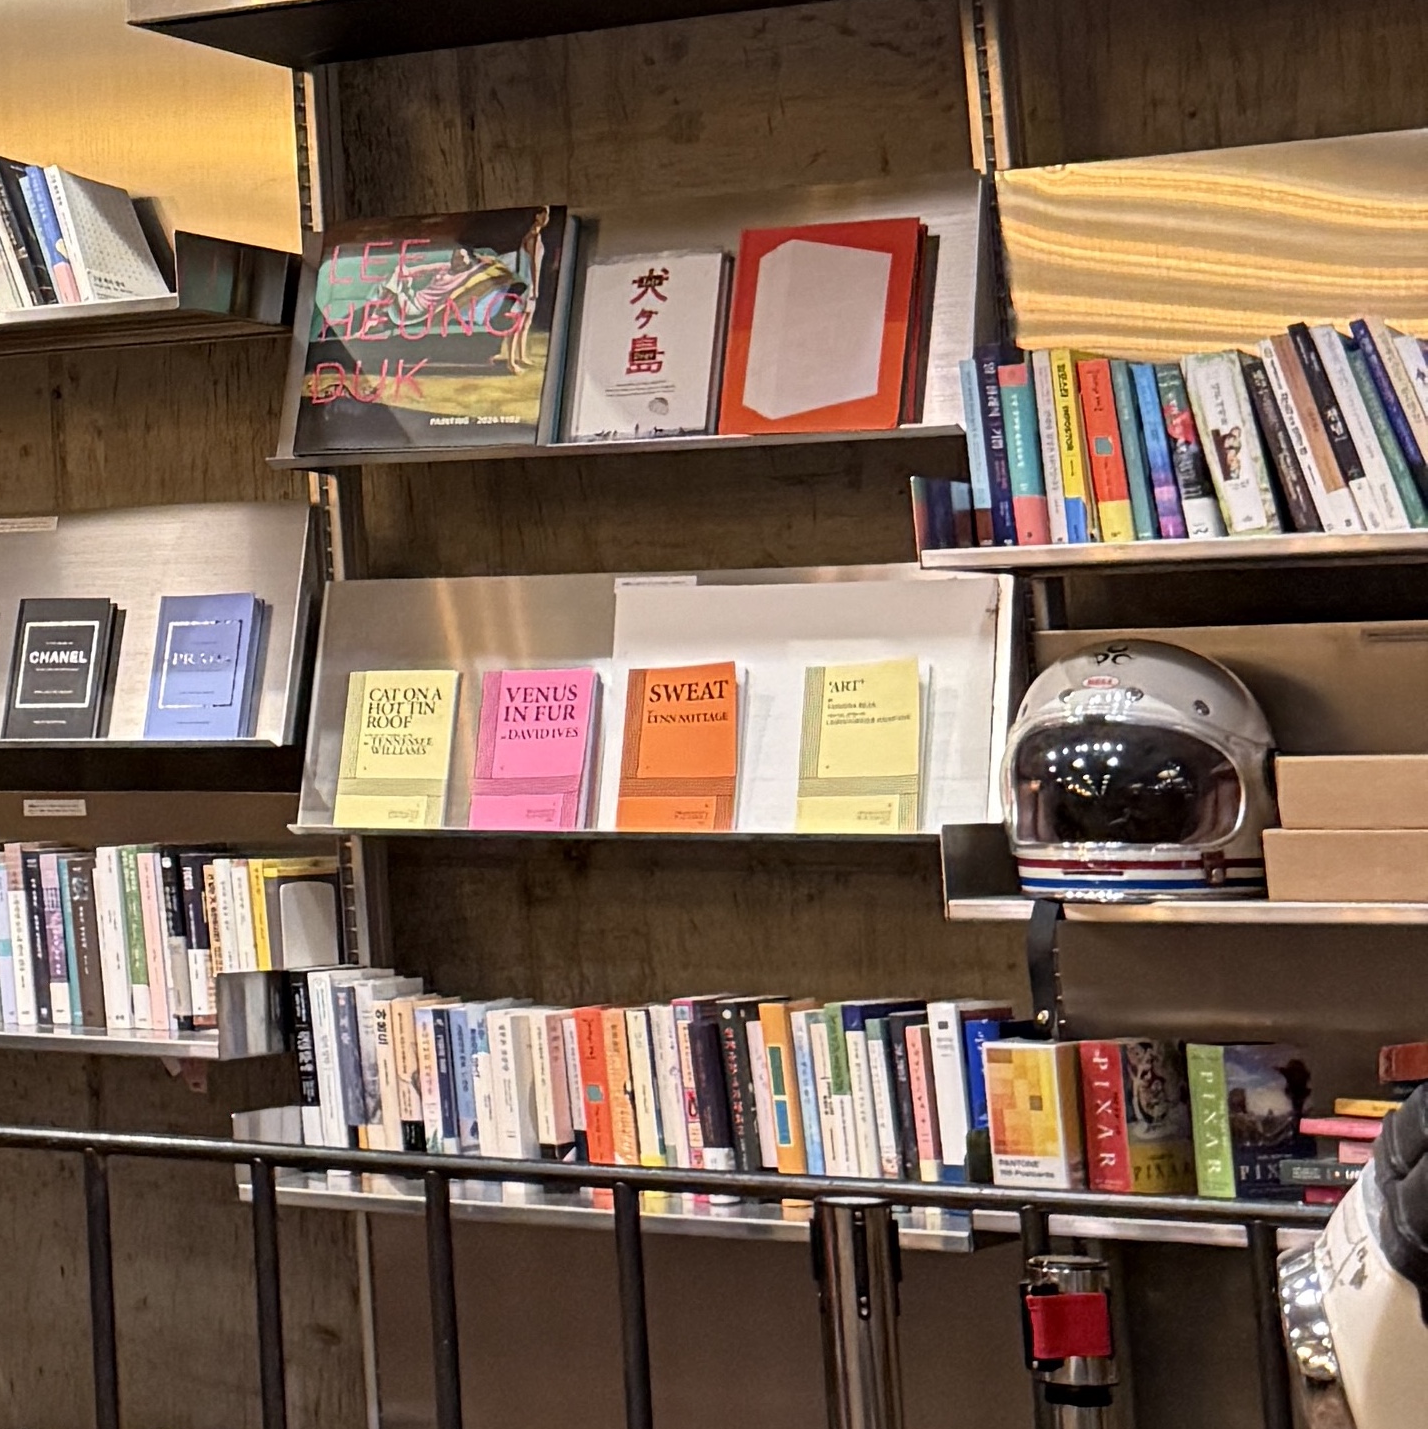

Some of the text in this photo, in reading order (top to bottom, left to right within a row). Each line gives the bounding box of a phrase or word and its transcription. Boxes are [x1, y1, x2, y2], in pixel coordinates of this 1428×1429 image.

[328, 239, 431, 285] LEE
[320, 292, 523, 342] HEUNG
[312, 358, 429, 404] DUK
[29, 649, 88, 665] CHANEL
[369, 686, 442, 702] CAT ON A
[505, 683, 579, 703] VENUS
[648, 679, 730, 703] SWEAT
[368, 701, 436, 715] HOT TIN
[503, 702, 576, 723] IN FUR
[366, 714, 413, 729] ROOF
[507, 728, 551, 741] DAVID
[1093, 1055, 1116, 1167] PIXAR
[1200, 1071, 1222, 1173] PIXAR
[998, 1158, 1040, 1168] PANTONE
[1240, 1164, 1280, 1181] PIX
